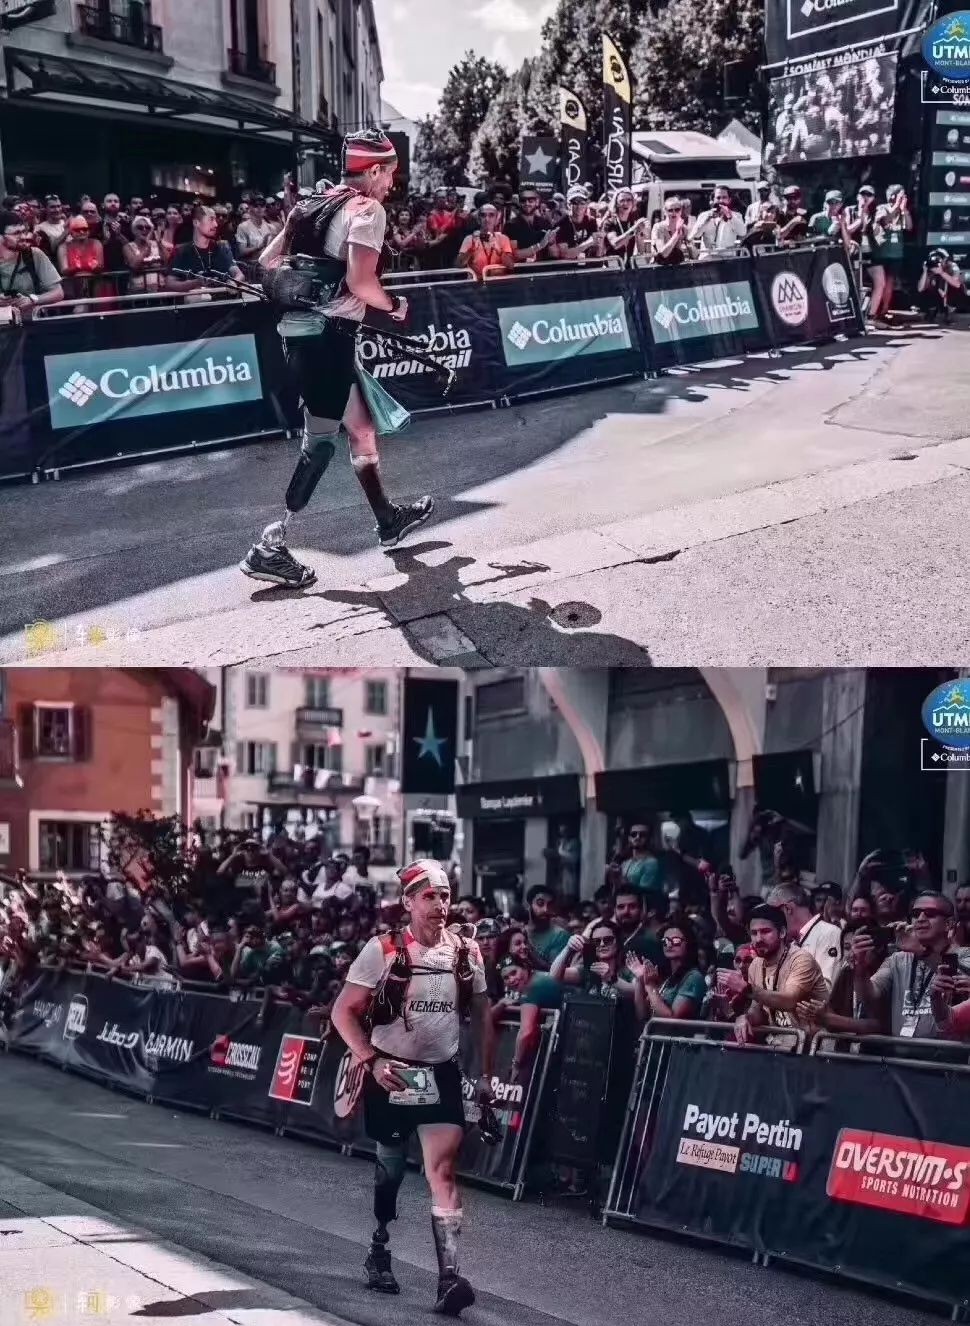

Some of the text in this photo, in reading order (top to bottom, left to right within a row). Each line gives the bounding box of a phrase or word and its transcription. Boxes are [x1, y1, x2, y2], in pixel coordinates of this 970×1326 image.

[673, 296, 750, 324] Columbia
[532, 314, 623, 345] Columbia
[100, 356, 252, 398] Columbia
[683, 1104, 803, 1151] Payot Pertin
[861, 1176, 959, 1208] SPORTS NUTRITION
